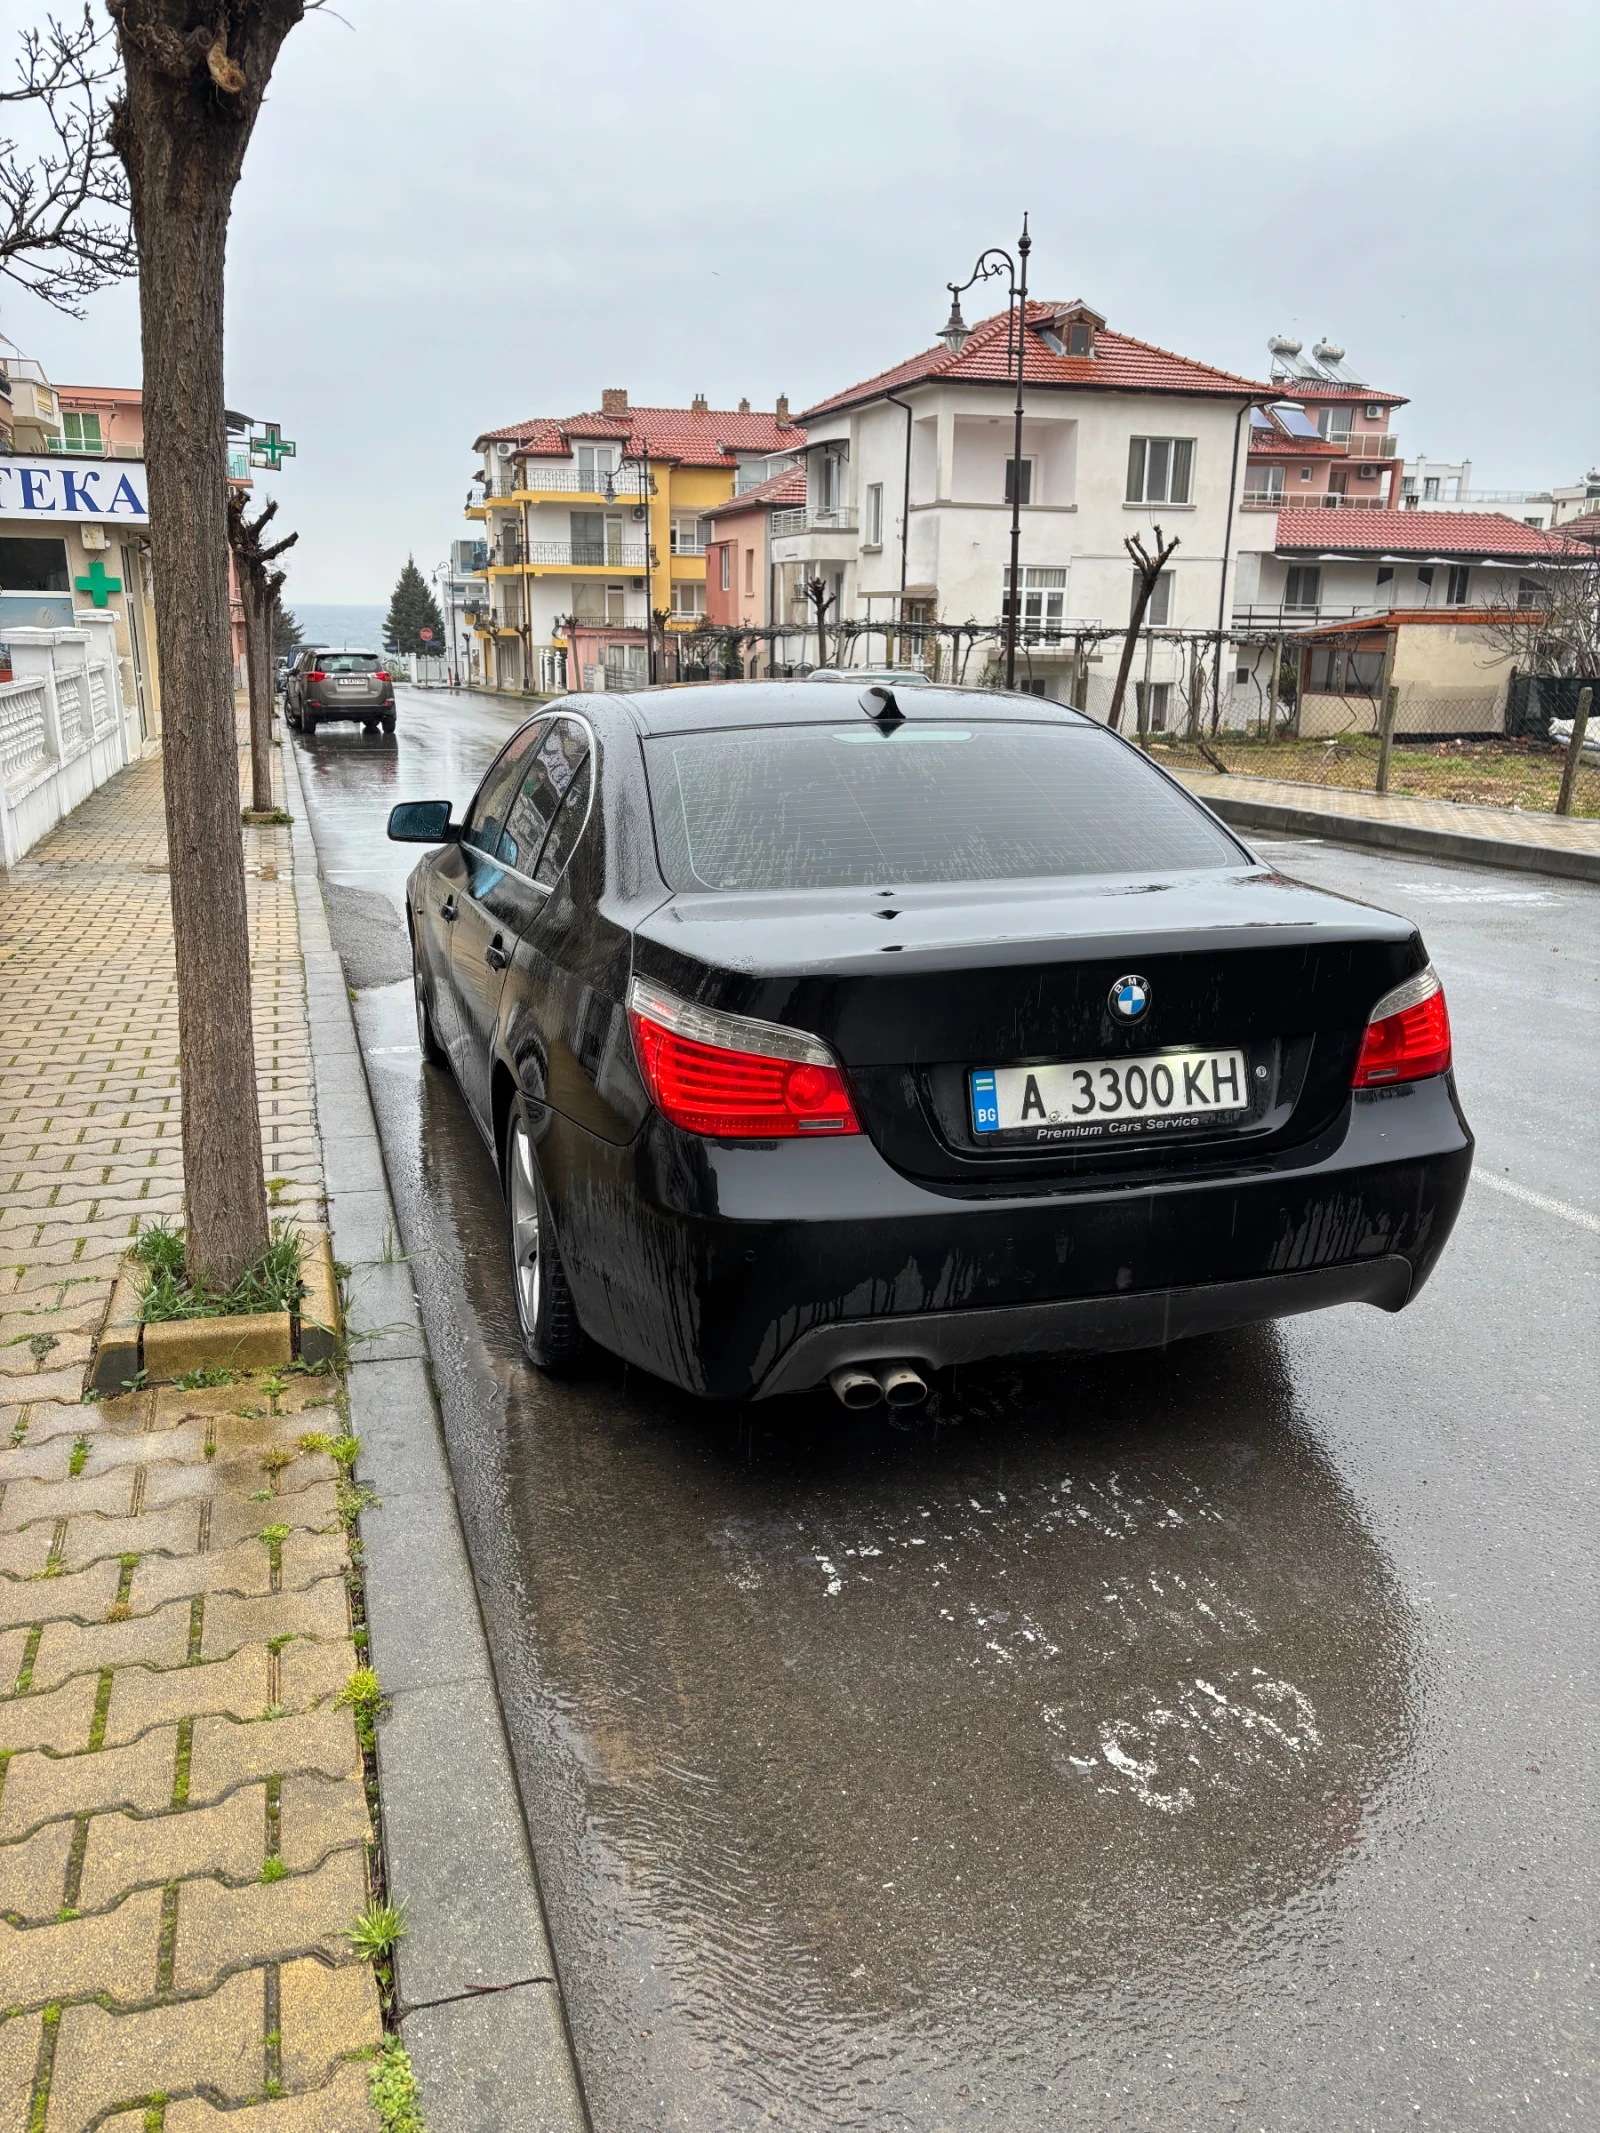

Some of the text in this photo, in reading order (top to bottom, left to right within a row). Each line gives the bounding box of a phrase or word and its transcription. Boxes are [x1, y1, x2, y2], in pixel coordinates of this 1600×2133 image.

[1114, 977, 1149, 994] BMW
[1021, 1074, 1046, 1120] A
[978, 1108, 996, 1122] BG
[1036, 1126, 1103, 1140] Premium
[1108, 1122, 1142, 1133] Cars
[1146, 1116, 1200, 1130] Service
